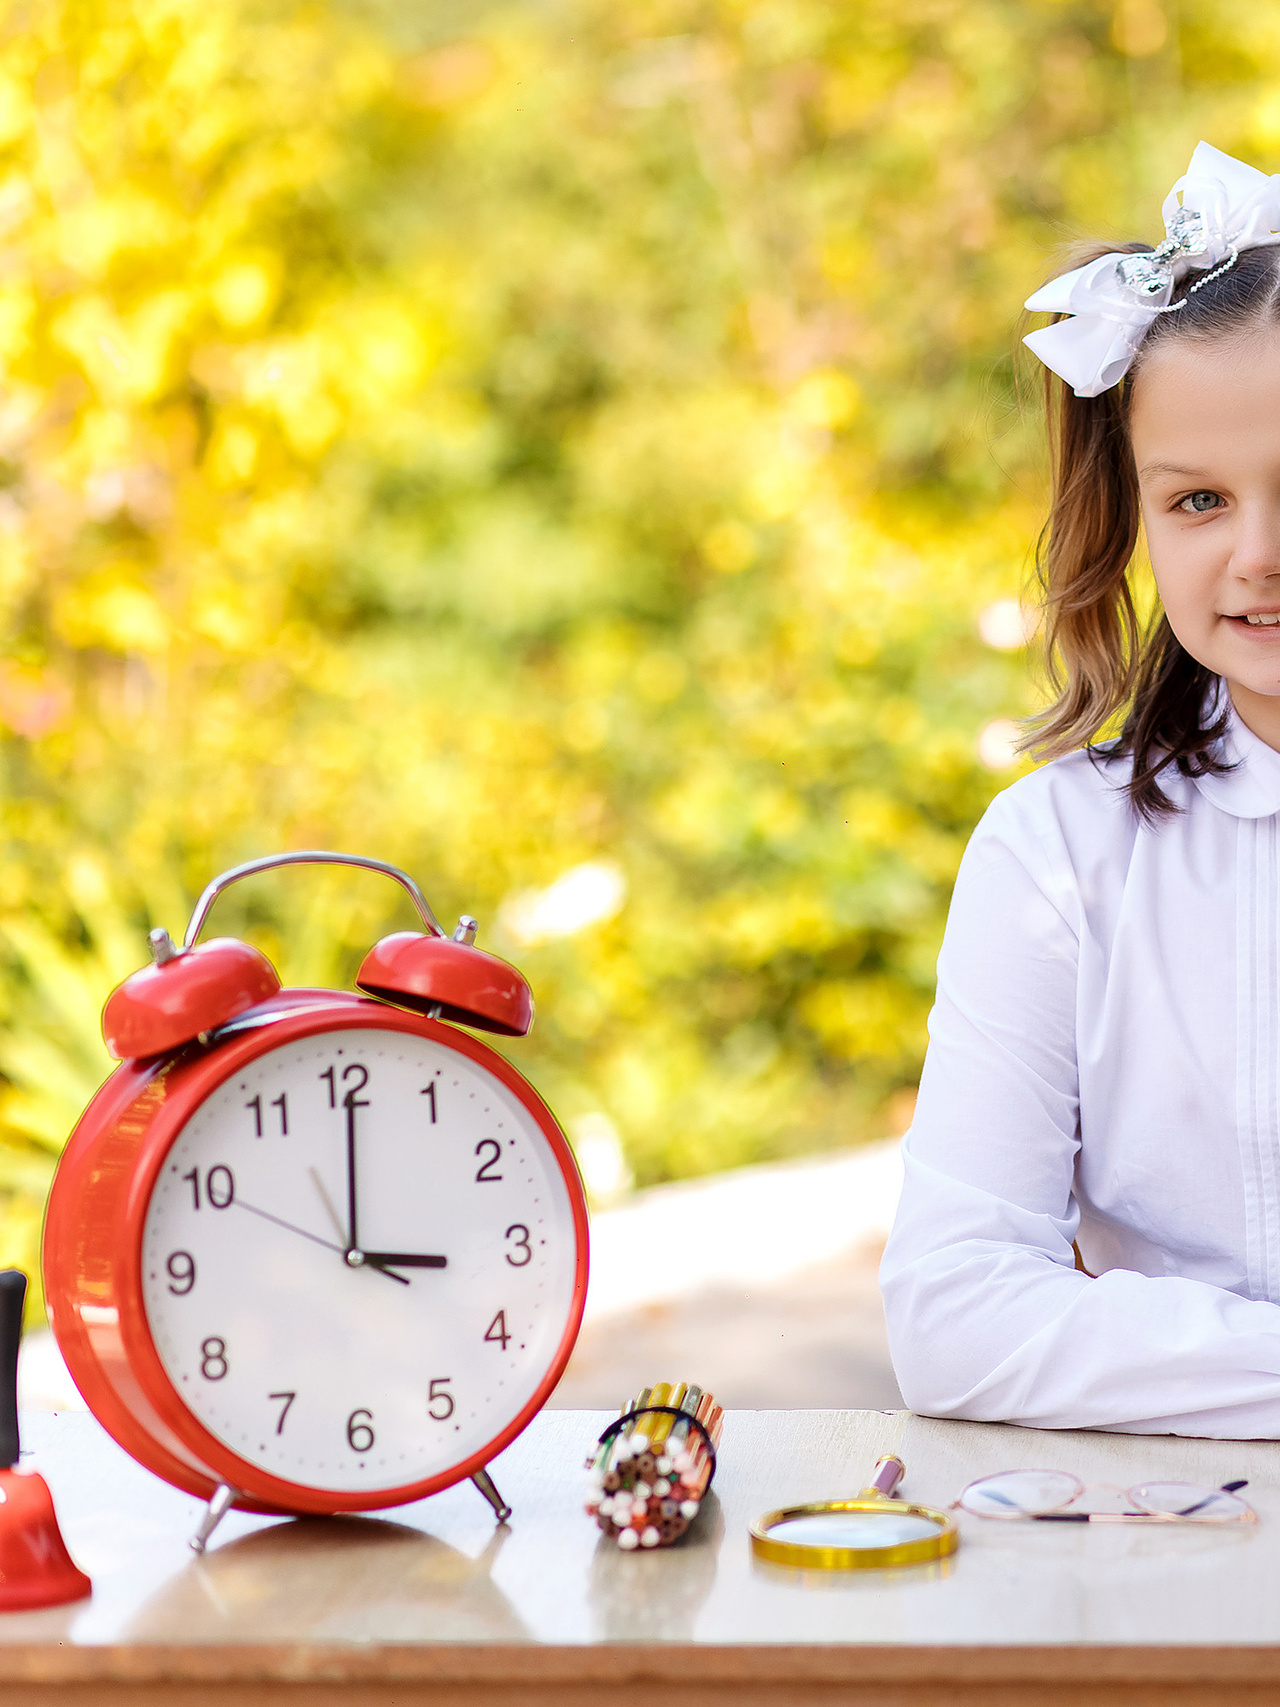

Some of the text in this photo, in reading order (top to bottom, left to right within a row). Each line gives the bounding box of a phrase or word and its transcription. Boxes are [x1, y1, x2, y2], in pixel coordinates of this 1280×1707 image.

[318, 1063, 370, 1109] 12
[419, 1080, 436, 1123] 1
[244, 1092, 288, 1137] 11
[474, 1138, 502, 1182] 2
[181, 1164, 234, 1210] 10
[505, 1223, 531, 1266] 3
[165, 1250, 195, 1296] 9
[483, 1309, 511, 1350] 4
[200, 1336, 227, 1381] 8
[269, 1392, 295, 1434] 7
[428, 1377, 453, 1420] 5
[346, 1409, 374, 1452] 6
